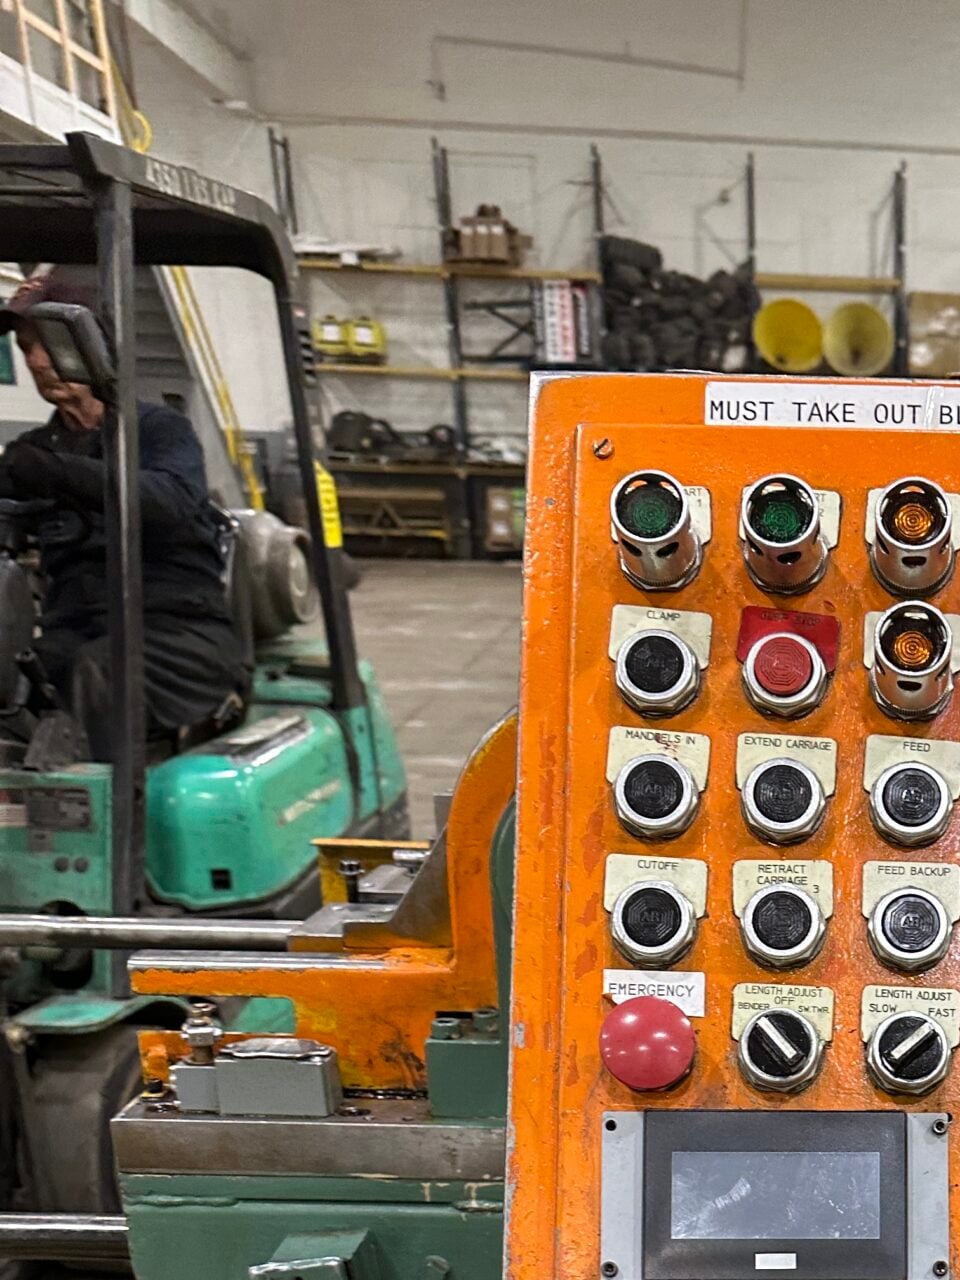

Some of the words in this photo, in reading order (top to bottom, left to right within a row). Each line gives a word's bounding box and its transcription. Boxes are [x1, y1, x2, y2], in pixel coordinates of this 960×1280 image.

[710, 401, 774, 421] MUST
[792, 402, 856, 423] TAKE
[874, 403, 922, 424] OUT
[646, 610, 681, 622] CLAMP
[686, 735, 696, 745] IN
[744, 736, 783, 748] EXTEND
[786, 739, 832, 751] CARRIAGE
[903, 741, 931, 753] FEED
[758, 864, 806, 874] RETRACT
[877, 865, 906, 876] FEED
[910, 867, 952, 877] BACKUP
[757, 875, 808, 886] CARRIAGE
[813, 884, 820, 894] 3
[608, 983, 695, 998] EMERGENCY
[745, 985, 783, 995] LENGTH
[787, 987, 823, 998] ADJUST
[875, 988, 913, 1000] LENGTH
[916, 990, 952, 1001] ADJUST
[738, 1001, 770, 1011] BENDER
[774, 996, 795, 1006] OFF
[868, 1003, 897, 1013] SLOW
[928, 1007, 957, 1018] FAST
